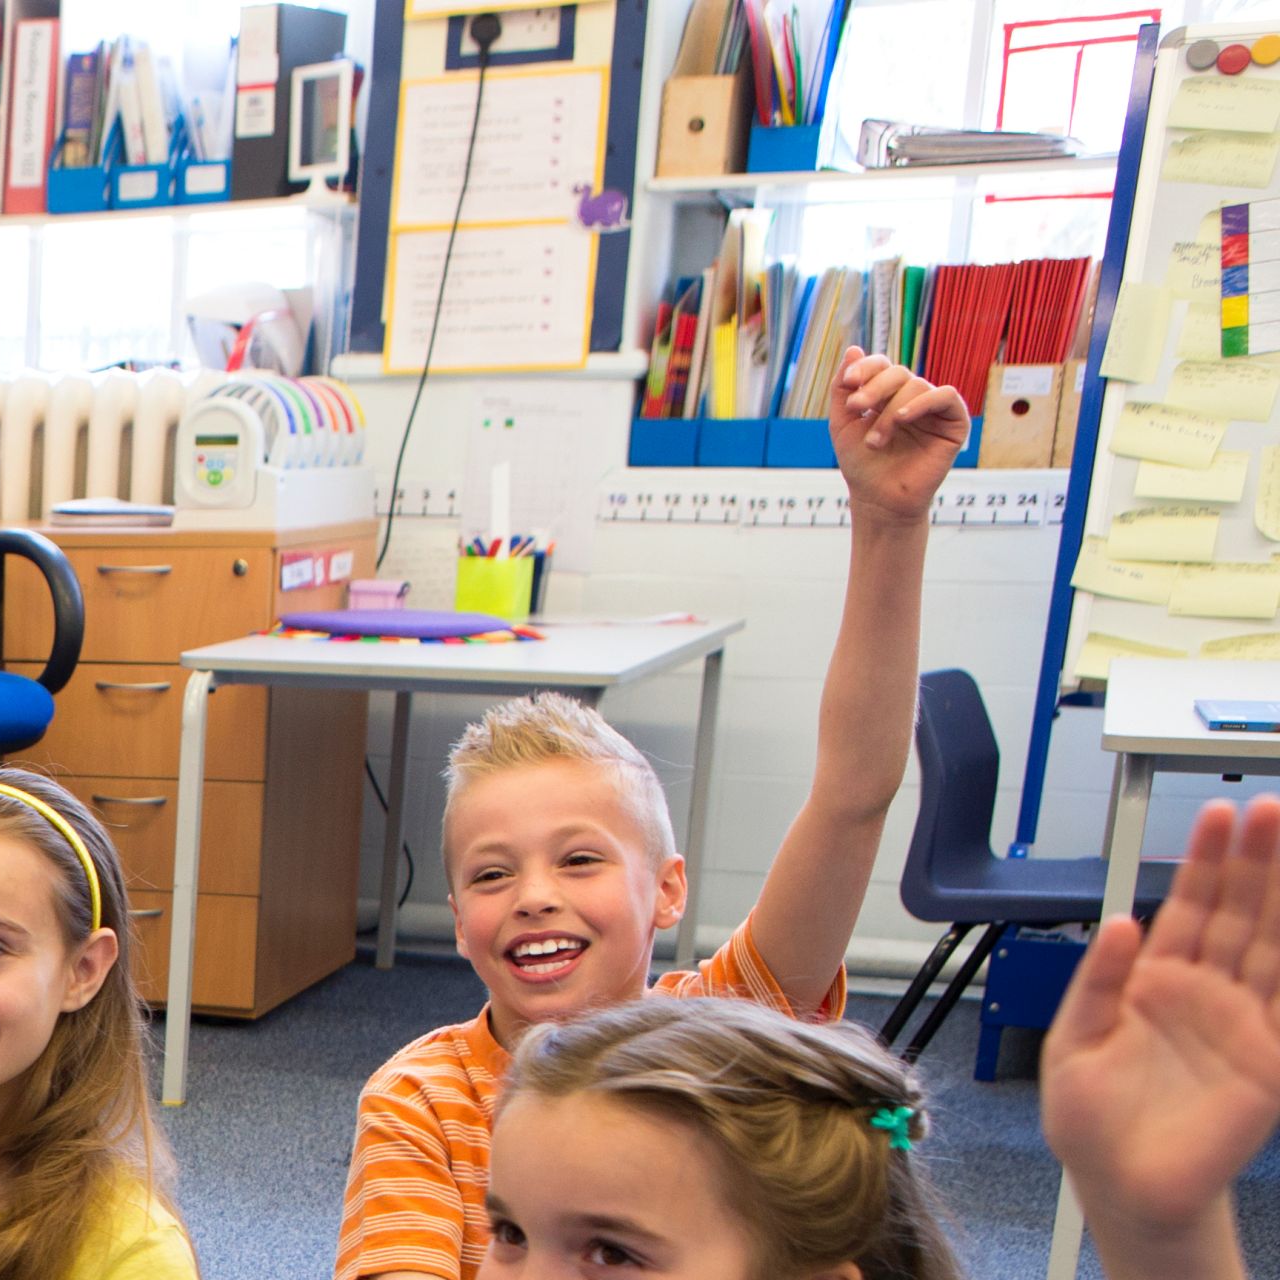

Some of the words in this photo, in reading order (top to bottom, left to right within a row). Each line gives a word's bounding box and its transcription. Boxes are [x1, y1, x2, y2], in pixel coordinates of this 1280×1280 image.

[608, 493, 627, 506] 10
[637, 493, 653, 505] 11
[664, 493, 682, 506] 12
[692, 493, 709, 506] 13
[719, 493, 737, 506] 14
[749, 497, 768, 510] 15
[778, 497, 795, 509] 16
[807, 497, 825, 509] 17
[956, 494, 976, 507] 22
[986, 494, 1007, 507] 23
[1017, 494, 1038, 507] 24
